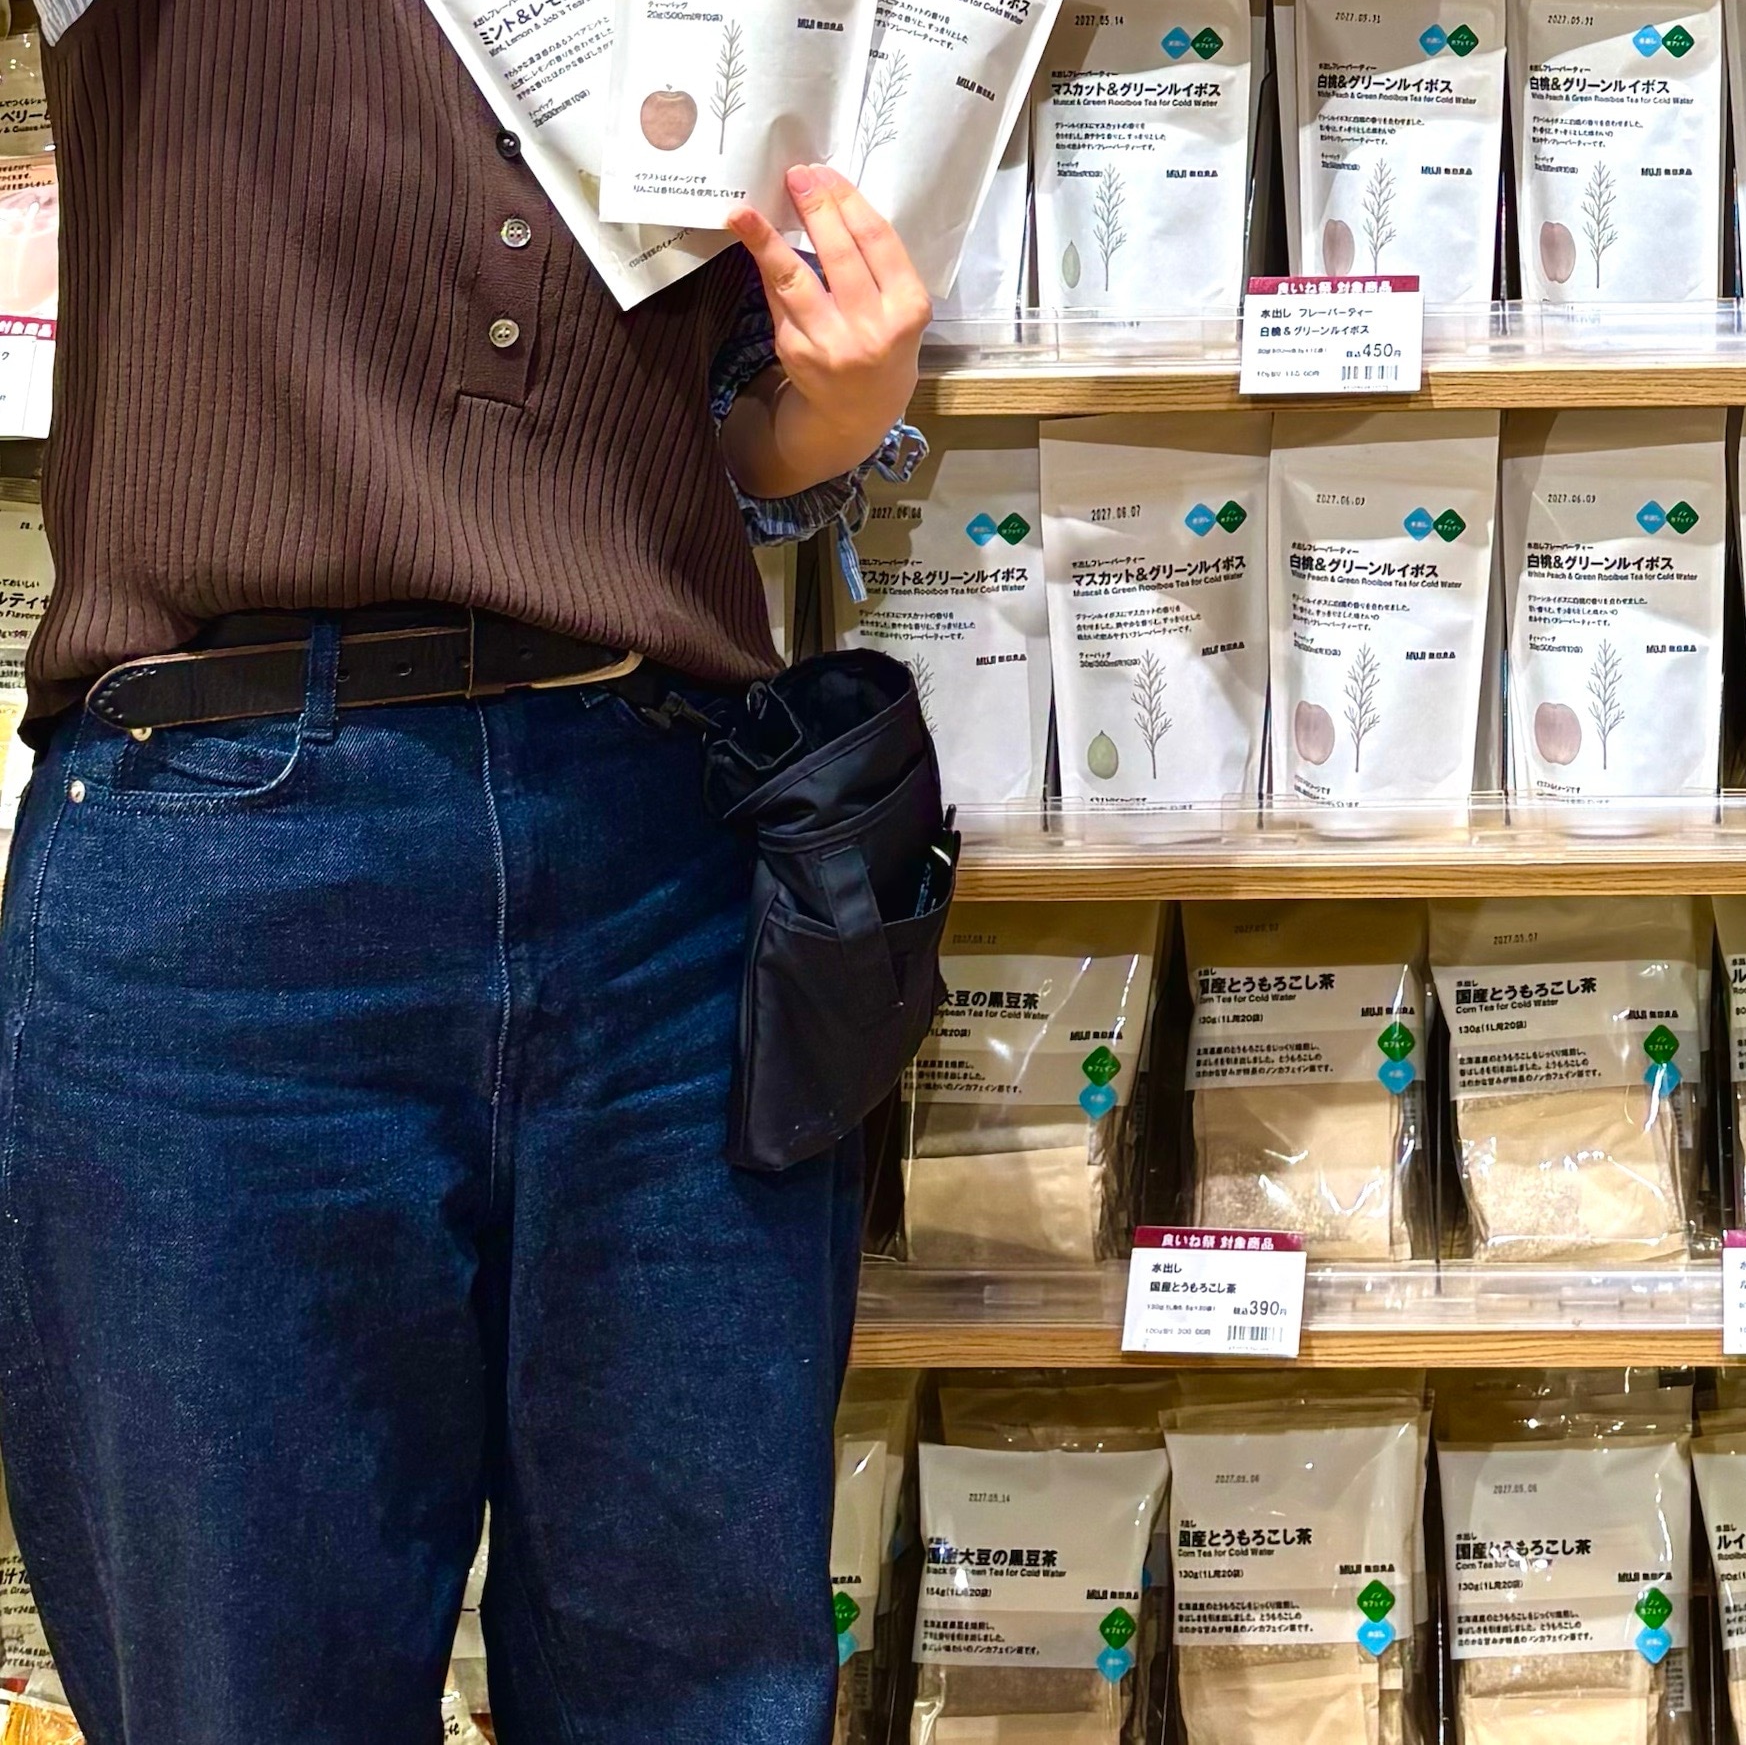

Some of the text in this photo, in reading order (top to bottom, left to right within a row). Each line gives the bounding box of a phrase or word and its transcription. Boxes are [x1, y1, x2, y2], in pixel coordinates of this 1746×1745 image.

[983, 0, 1003, 16] Cold
[506, 27, 534, 47] Lemon
[1051, 81, 1222, 99] マスカット&グリーンルイボス
[1317, 73, 1454, 94] 白桃&グリーンルイボス
[1529, 77, 1670, 95] 白桃&グリーンルイボス
[1260, 307, 1373, 318] 水出し フレーバーティー
[1072, 555, 1246, 585] マスカット&グリーンルイボス
[1289, 554, 1438, 578] 白桃&グリーンルイボス
[1526, 553, 1674, 571] 白桃&グリーンルイボス
[1456, 976, 1597, 1005] 国産とうもろこし茶
[1479, 1003, 1495, 1012] Tea
[1496, 1002, 1509, 1011] for
[1511, 1000, 1532, 1009] Cold
[1534, 998, 1559, 1007] Water
[1162, 1233, 1215, 1248] 良いね祭
[1151, 1263, 1182, 1274] 水出し
[1149, 1281, 1237, 1294] 国産とうもろこし茶
[1178, 1527, 1312, 1547] 国産とうもろこし茶
[1455, 1538, 1591, 1560] 国産とうもろこし茶
